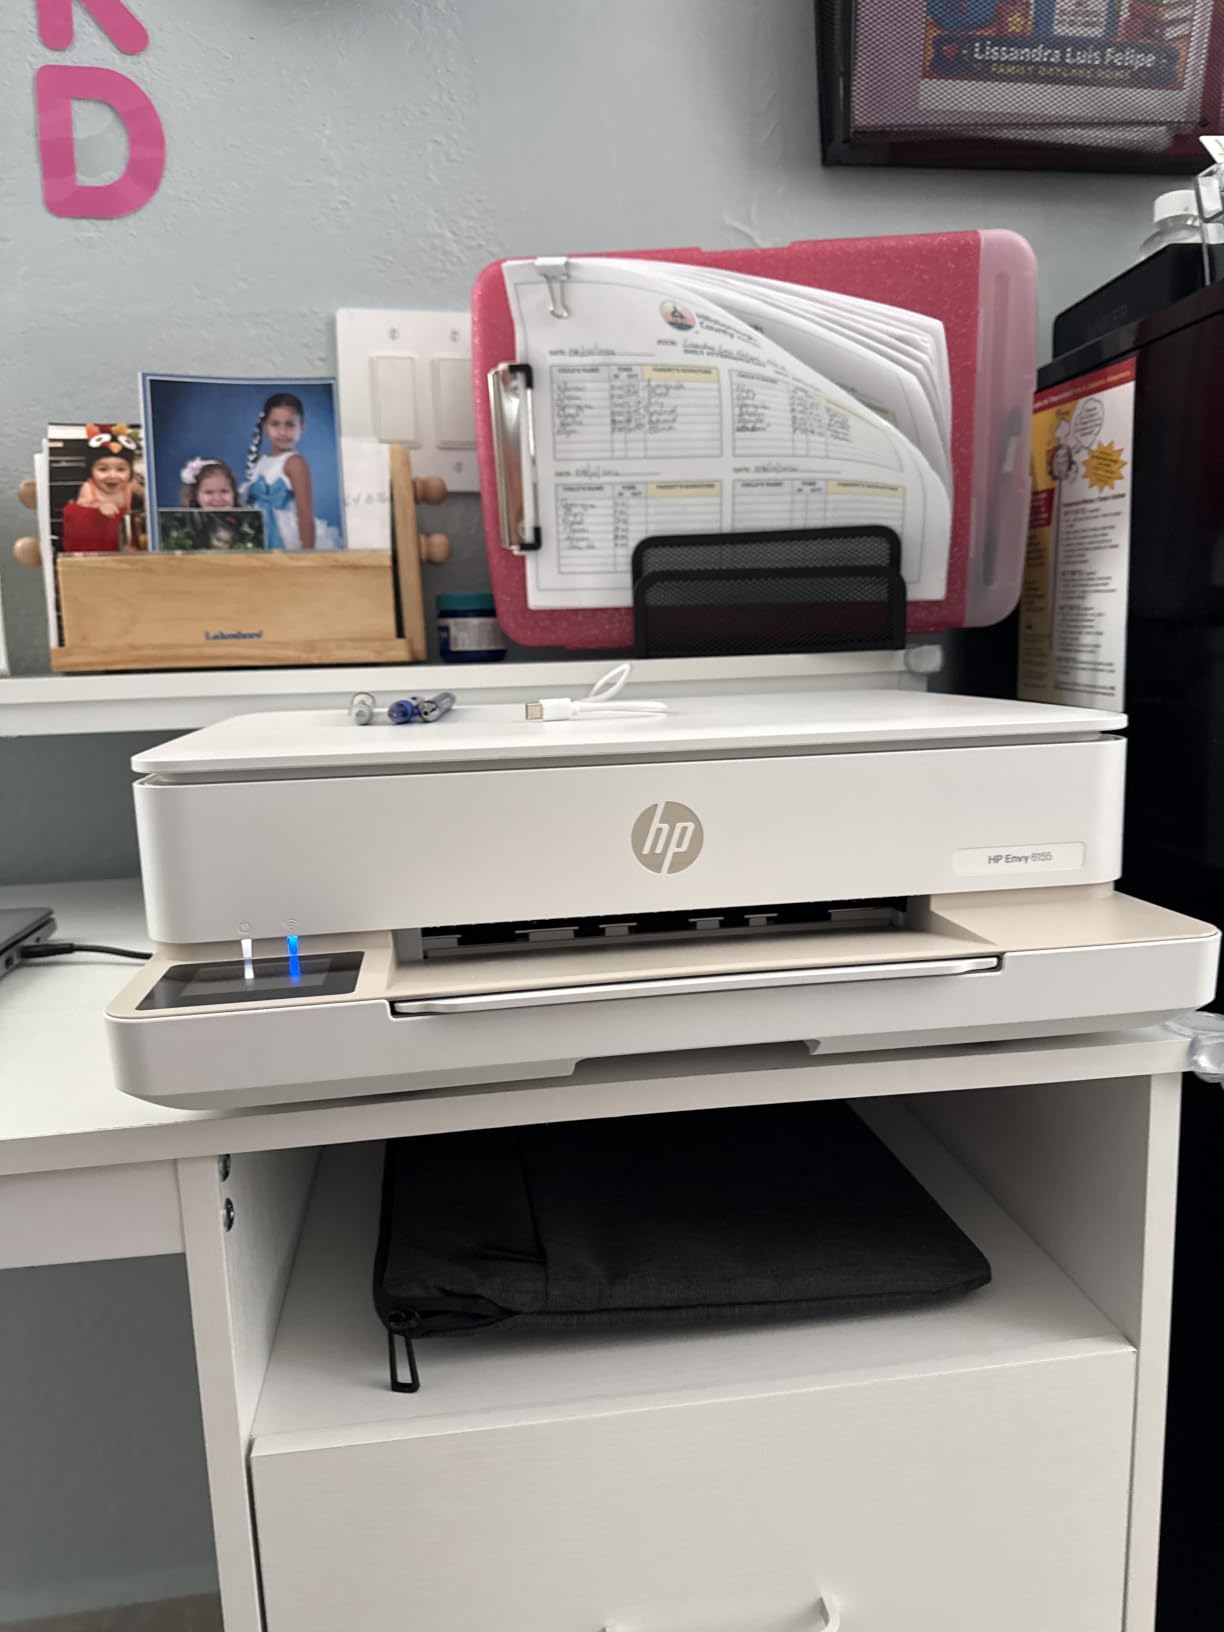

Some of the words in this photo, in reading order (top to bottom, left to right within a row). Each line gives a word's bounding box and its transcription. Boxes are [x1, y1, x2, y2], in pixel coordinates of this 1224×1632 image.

[642, 800, 695, 875] hp
[987, 854, 1003, 865] HP
[1005, 854, 1029, 864] Envy
